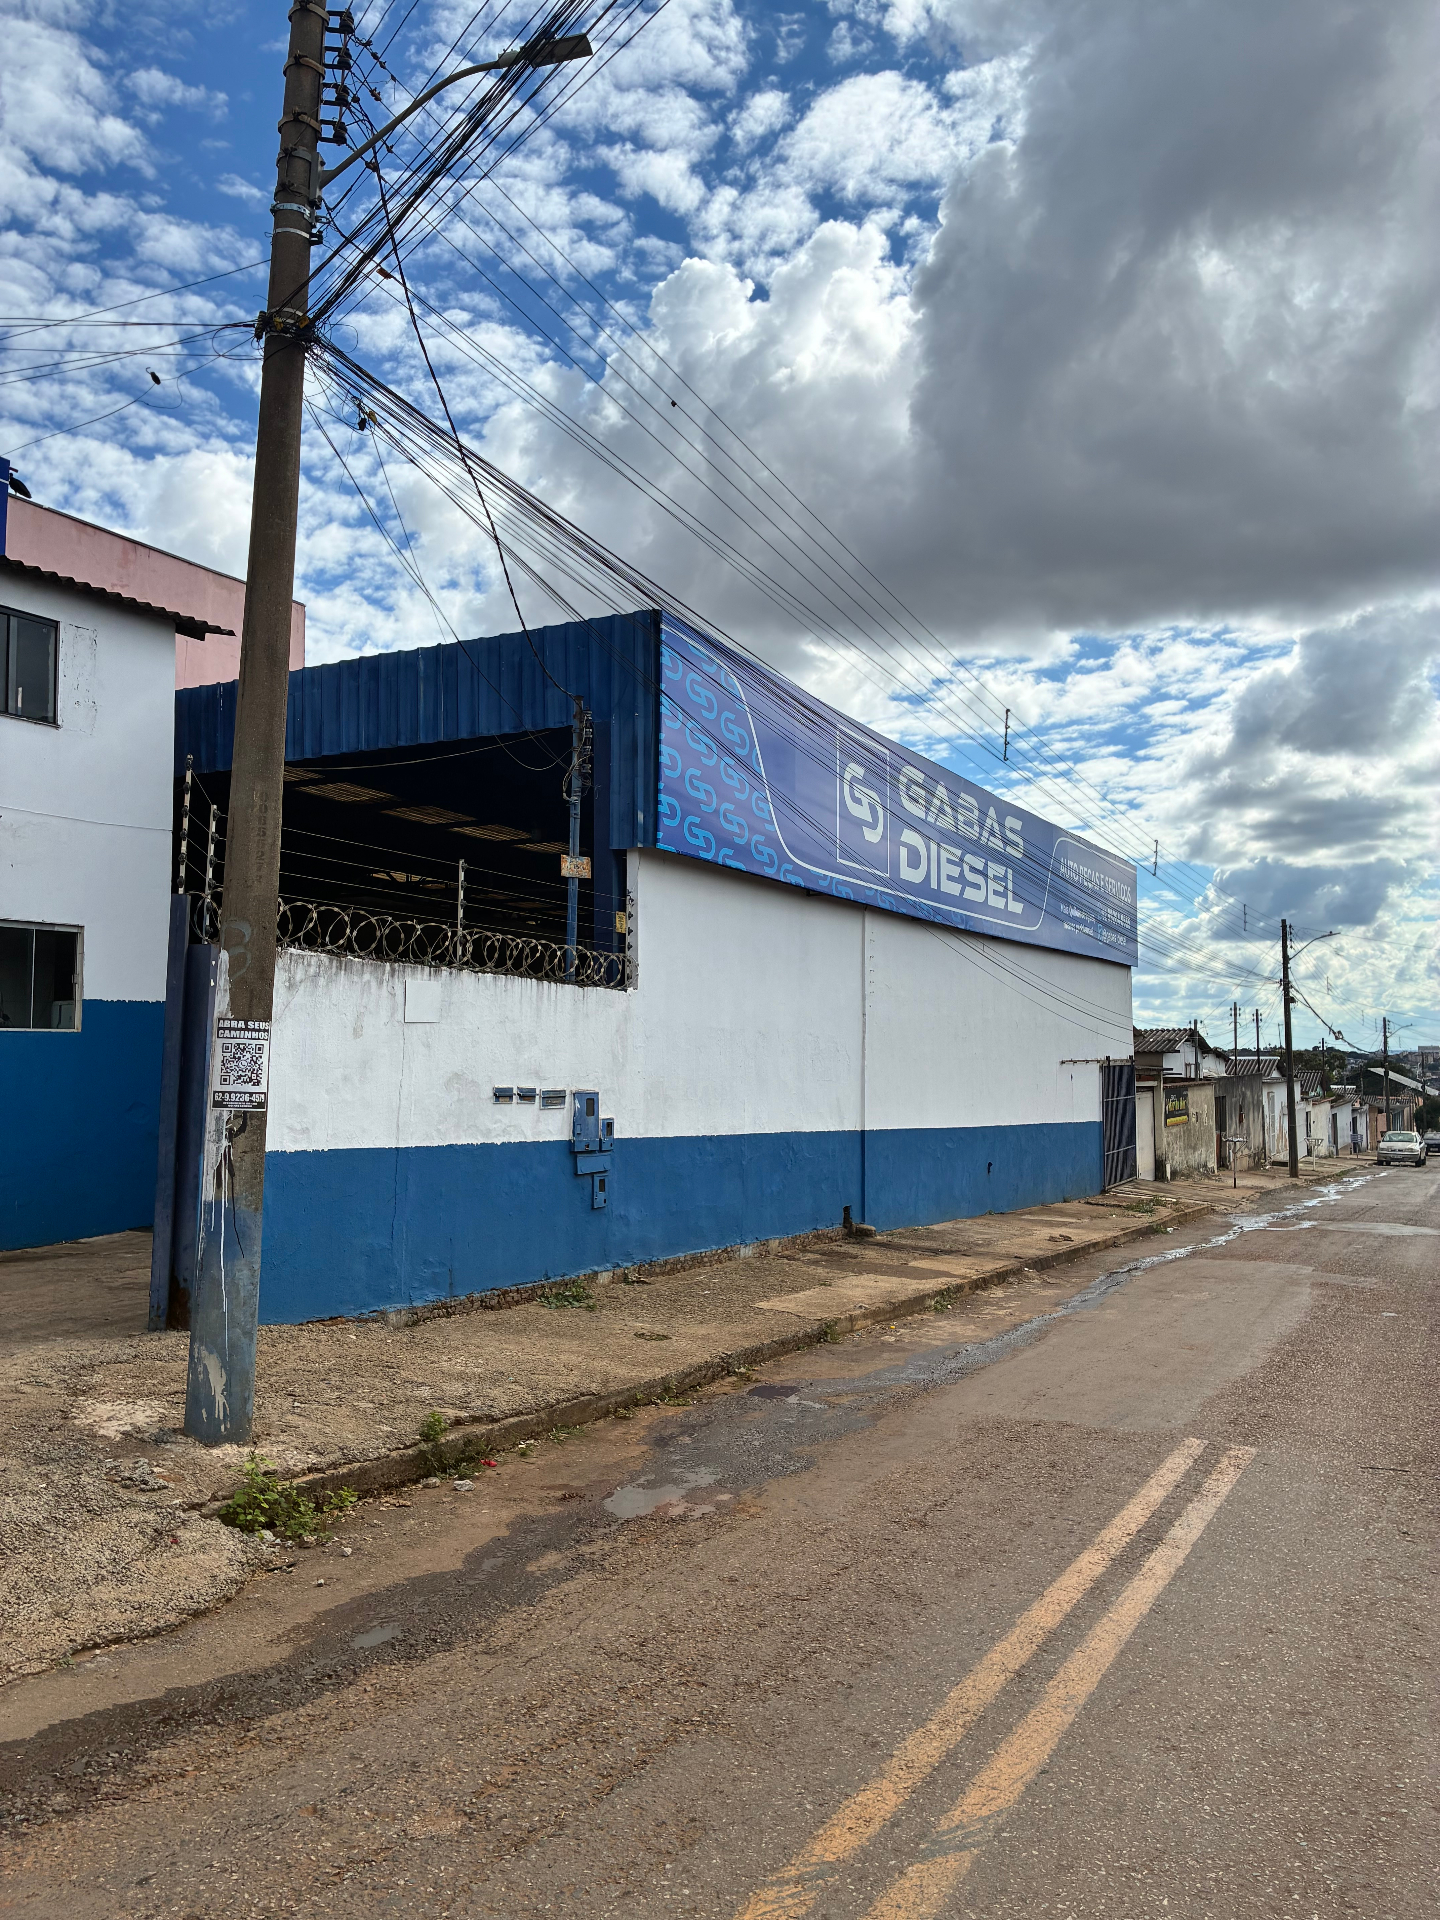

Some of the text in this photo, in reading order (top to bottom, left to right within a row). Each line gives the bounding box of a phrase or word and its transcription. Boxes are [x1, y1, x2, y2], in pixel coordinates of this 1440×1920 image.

[898, 765, 1025, 859] GABAS
[899, 828, 1025, 915] DIESEL
[1060, 857, 1079, 881] AUTO
[218, 1019, 270, 1030] ABRA SEUS
[218, 1029, 269, 1040] CAMINHOS
